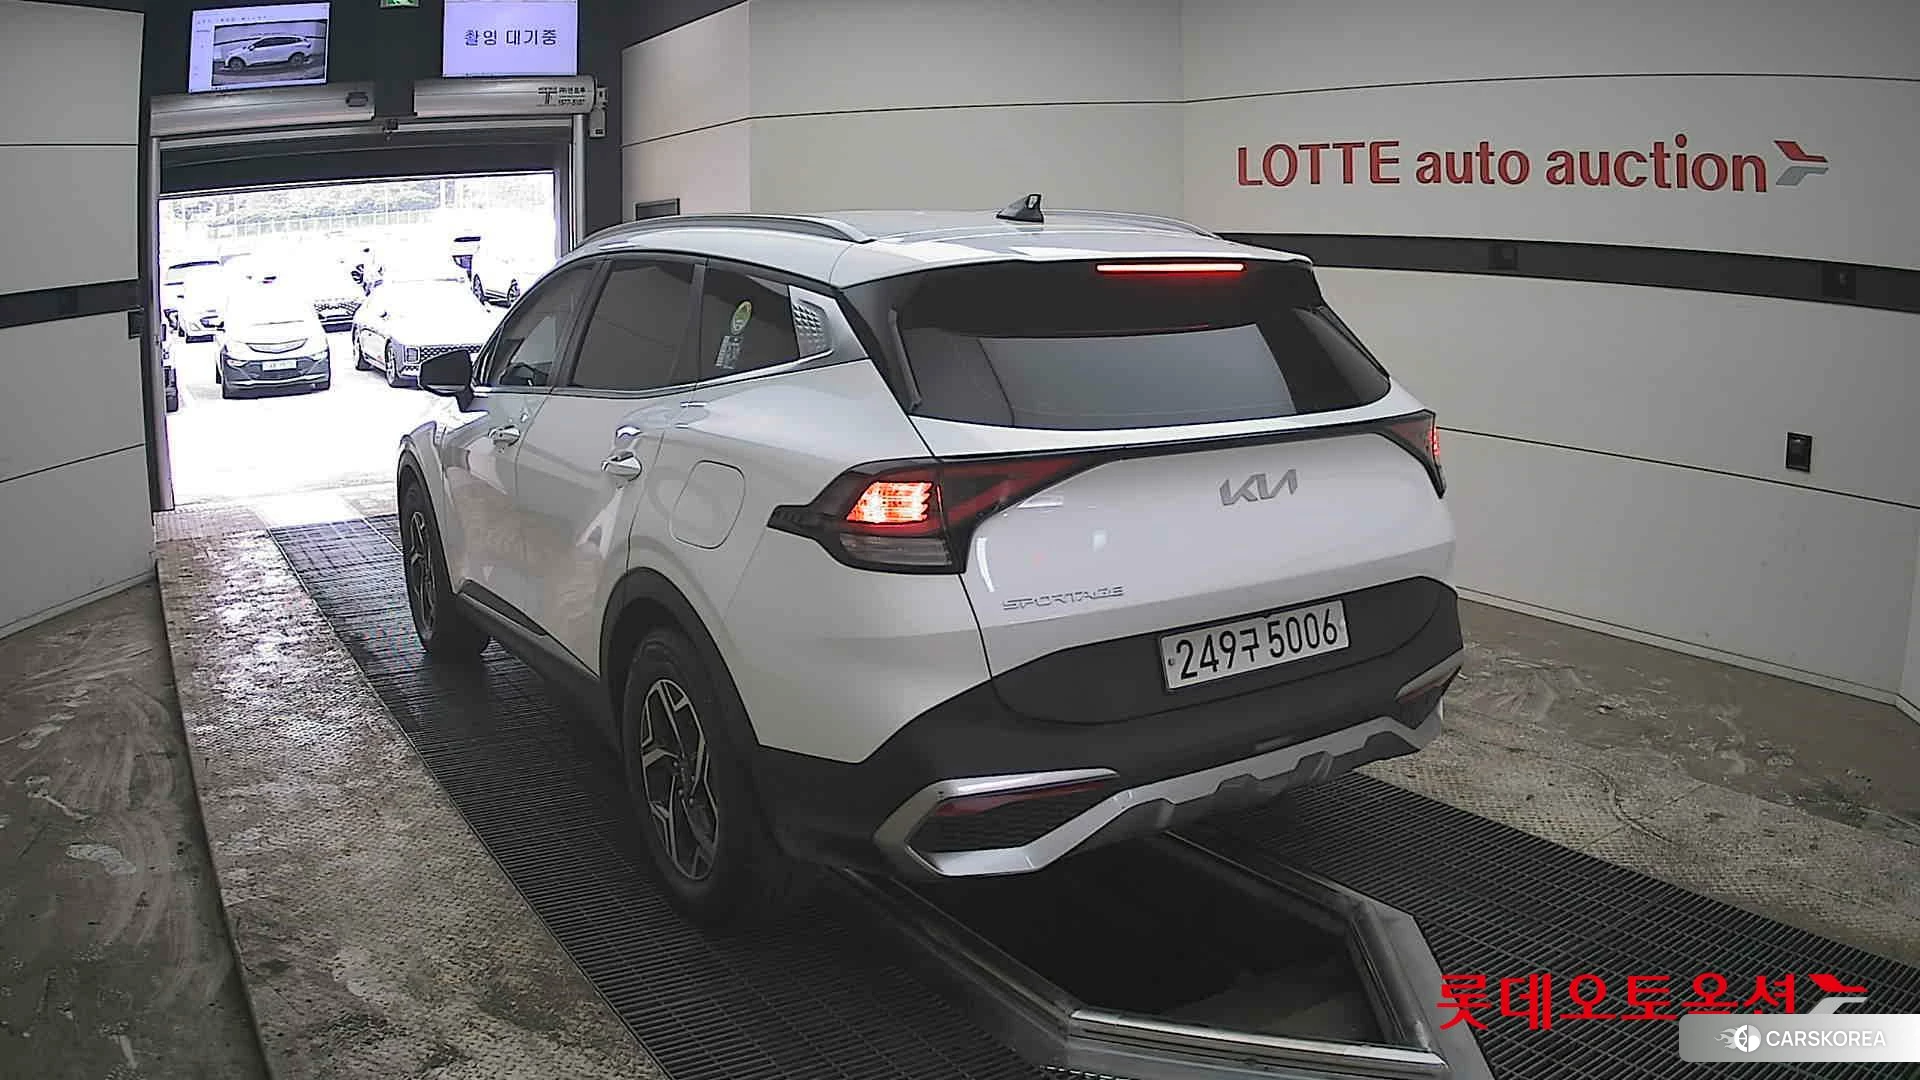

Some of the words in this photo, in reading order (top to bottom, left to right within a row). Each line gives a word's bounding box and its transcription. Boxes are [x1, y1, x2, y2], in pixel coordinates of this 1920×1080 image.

[506, 29, 557, 46] 대기중
[1237, 140, 1400, 187] LOTTE
[1415, 141, 1531, 186] auto
[1545, 133, 1767, 192] auction
[1219, 469, 1298, 506] KIA
[1003, 586, 1124, 610] SPORTAGE
